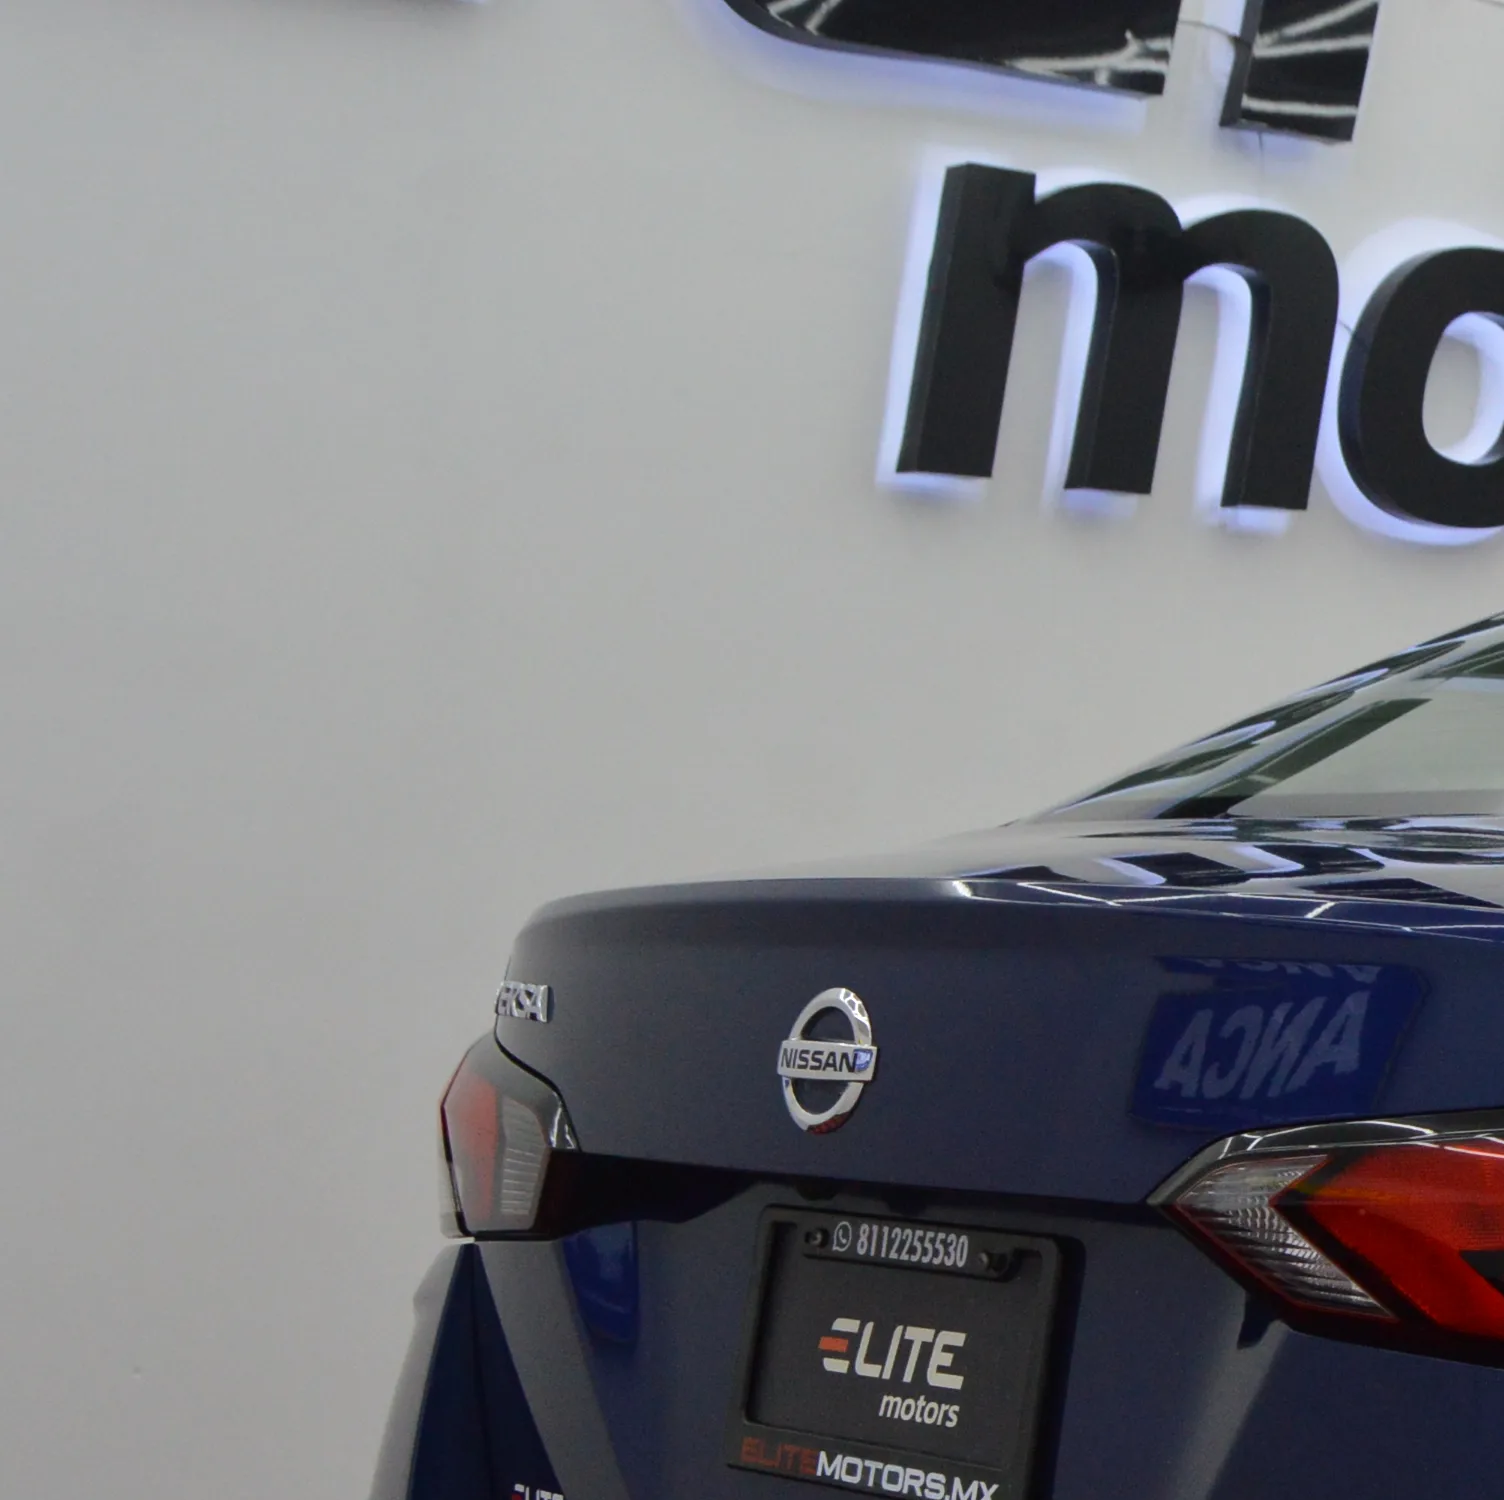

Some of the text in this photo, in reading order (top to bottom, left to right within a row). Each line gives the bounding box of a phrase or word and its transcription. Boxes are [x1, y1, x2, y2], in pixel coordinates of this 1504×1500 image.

[781, 1047, 858, 1073] NISSAN
[856, 1226, 969, 1268] 8112255530
[818, 1317, 967, 1390] ELITE
[879, 1393, 960, 1428] motors
